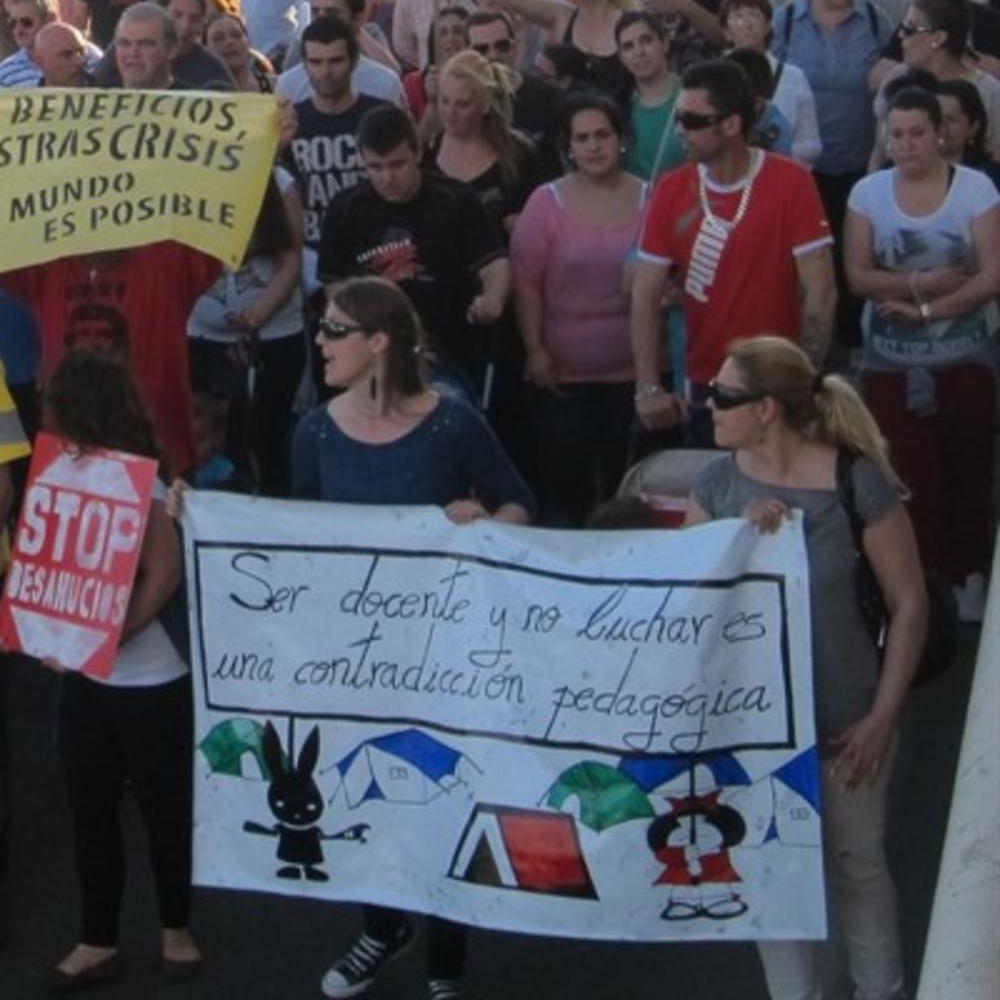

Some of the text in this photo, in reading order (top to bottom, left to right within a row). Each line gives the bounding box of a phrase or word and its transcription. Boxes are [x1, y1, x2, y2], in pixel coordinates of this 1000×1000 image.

[109, 121, 246, 173] CRISIS
[9, 172, 136, 223] MUNDO
[44, 193, 236, 243] ES POSIBLE
[17, 484, 141, 574] STOP
[229, 552, 767, 668] Ser docente y no luchar es
[211, 620, 772, 753] una contradicción pedagógica
